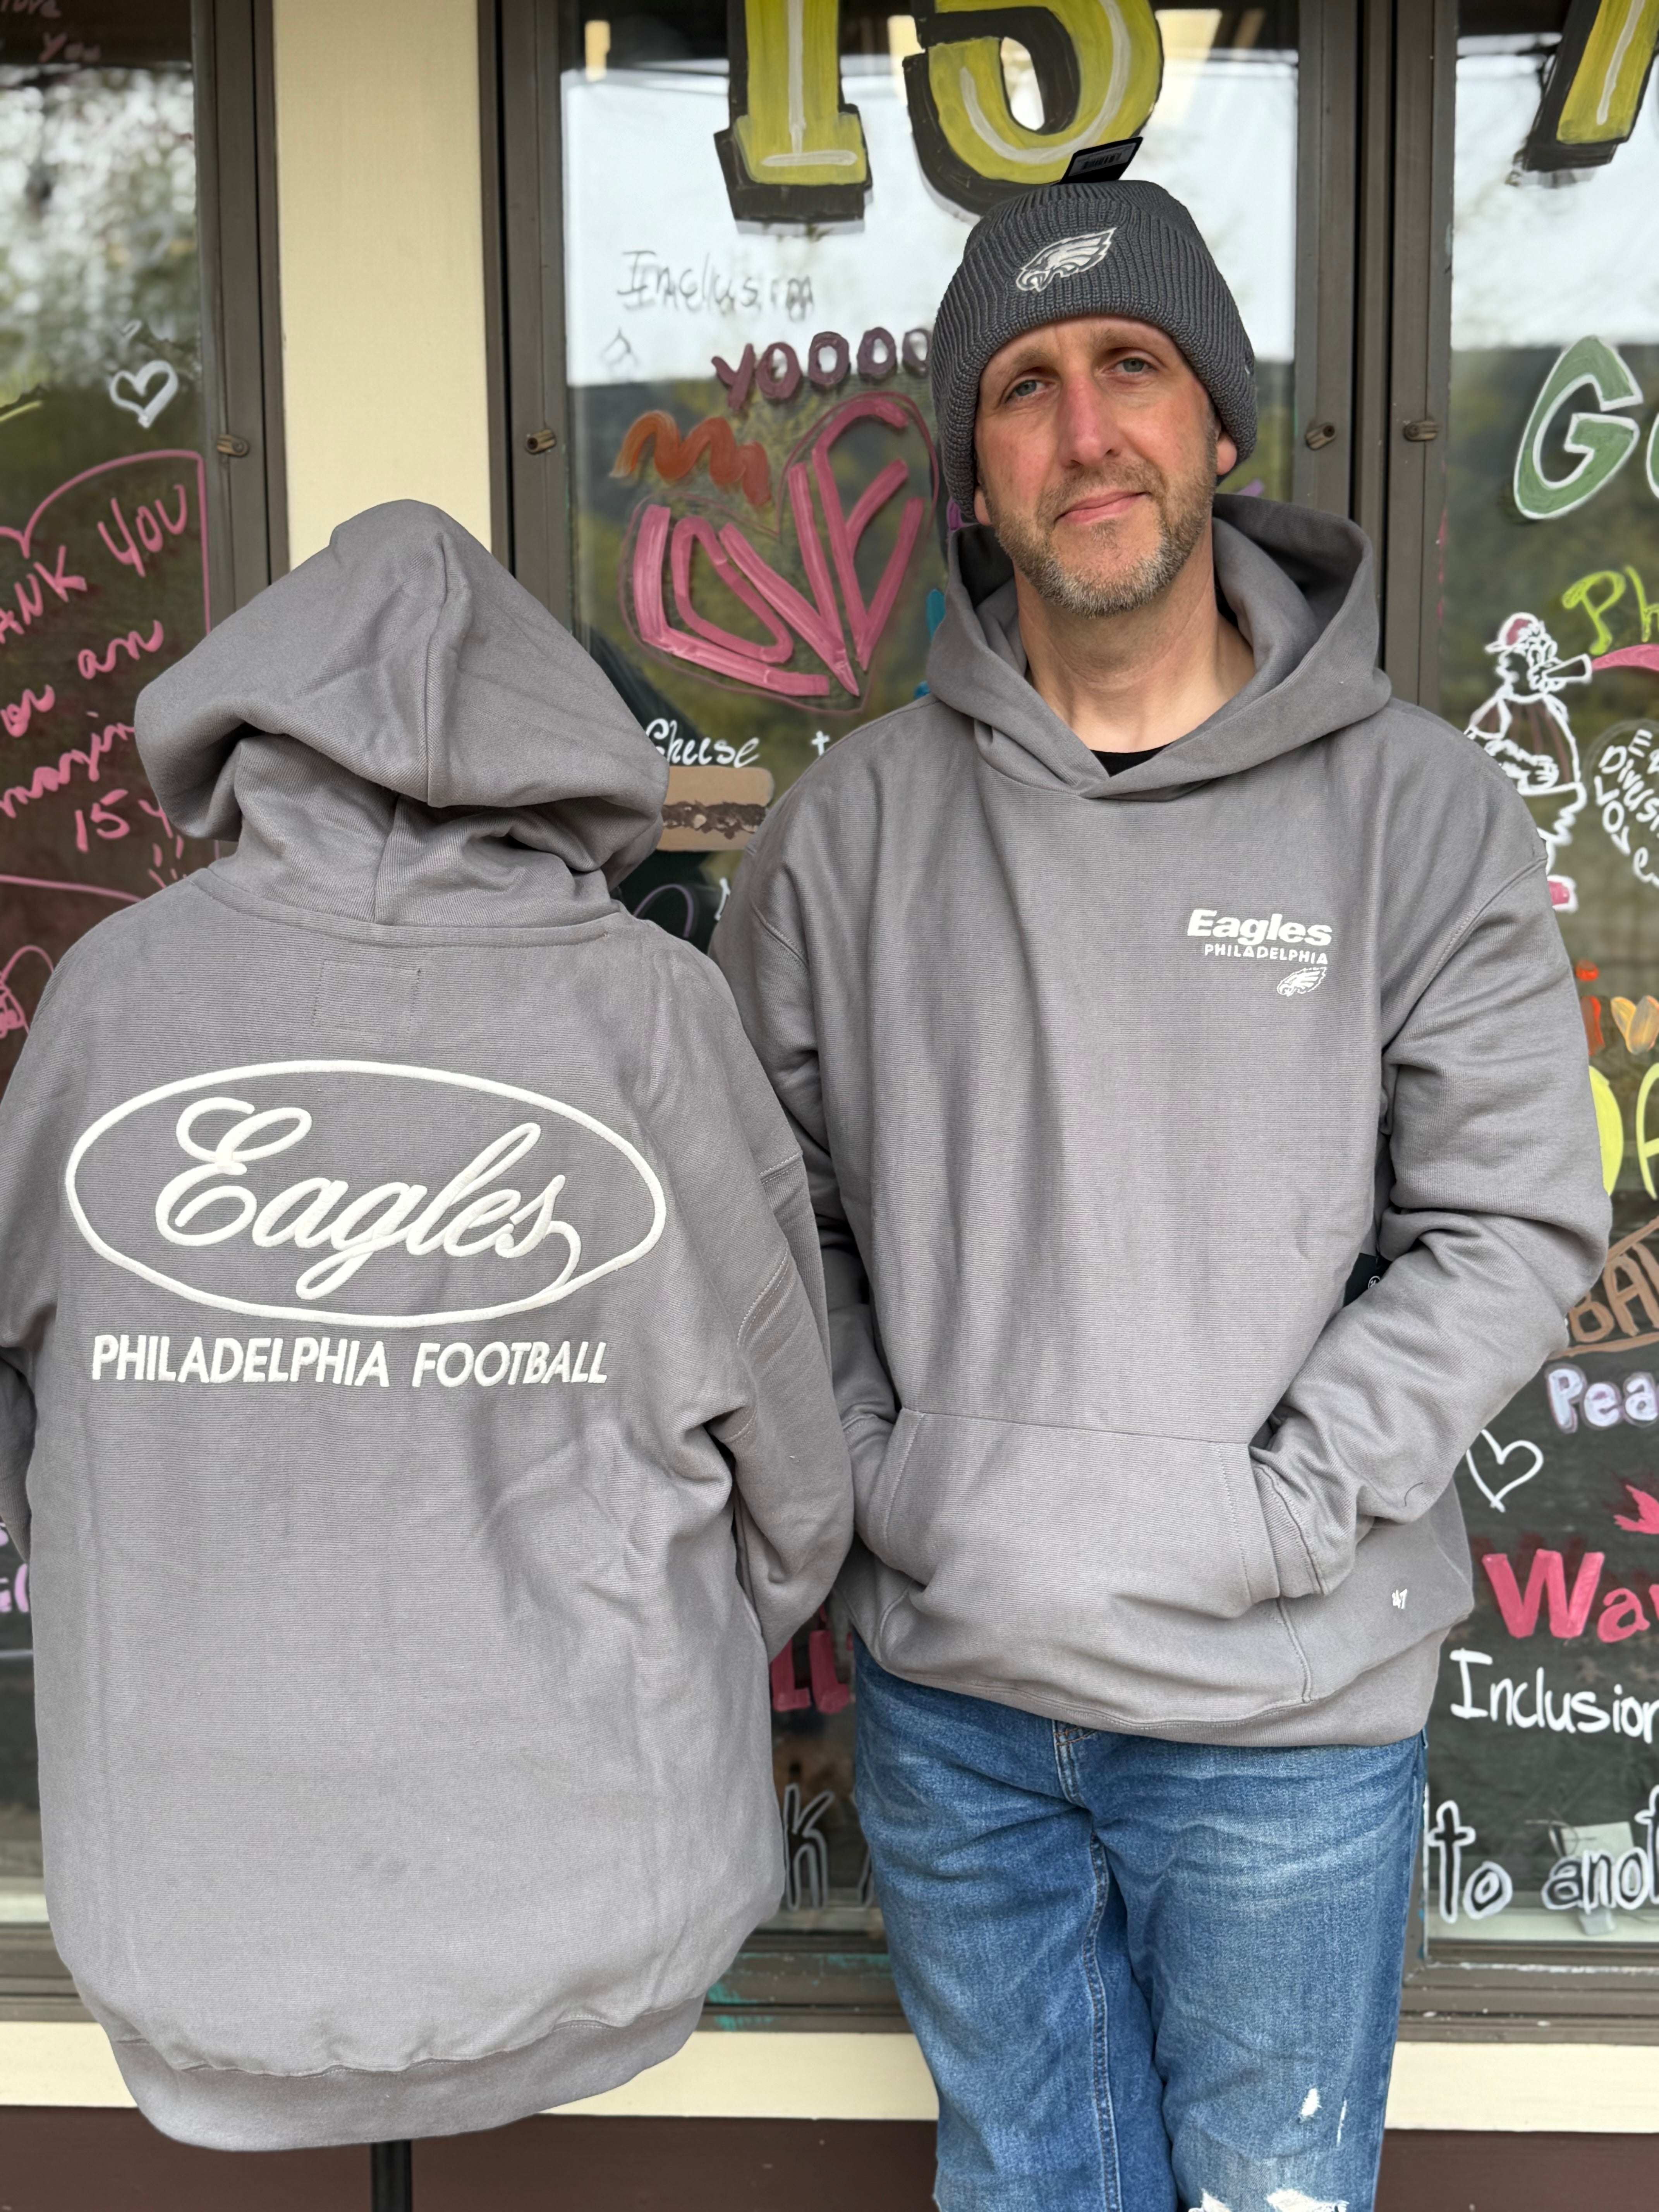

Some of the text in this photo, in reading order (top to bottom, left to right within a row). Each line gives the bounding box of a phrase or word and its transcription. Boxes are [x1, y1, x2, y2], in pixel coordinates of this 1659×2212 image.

[1187, 909, 1333, 946] Eagles
[1204, 943, 1328, 965] PHILADELPHIA
[156, 1097, 581, 1300] Eagles
[91, 1334, 608, 1388] PHILADELPHIA FOOTBALL
